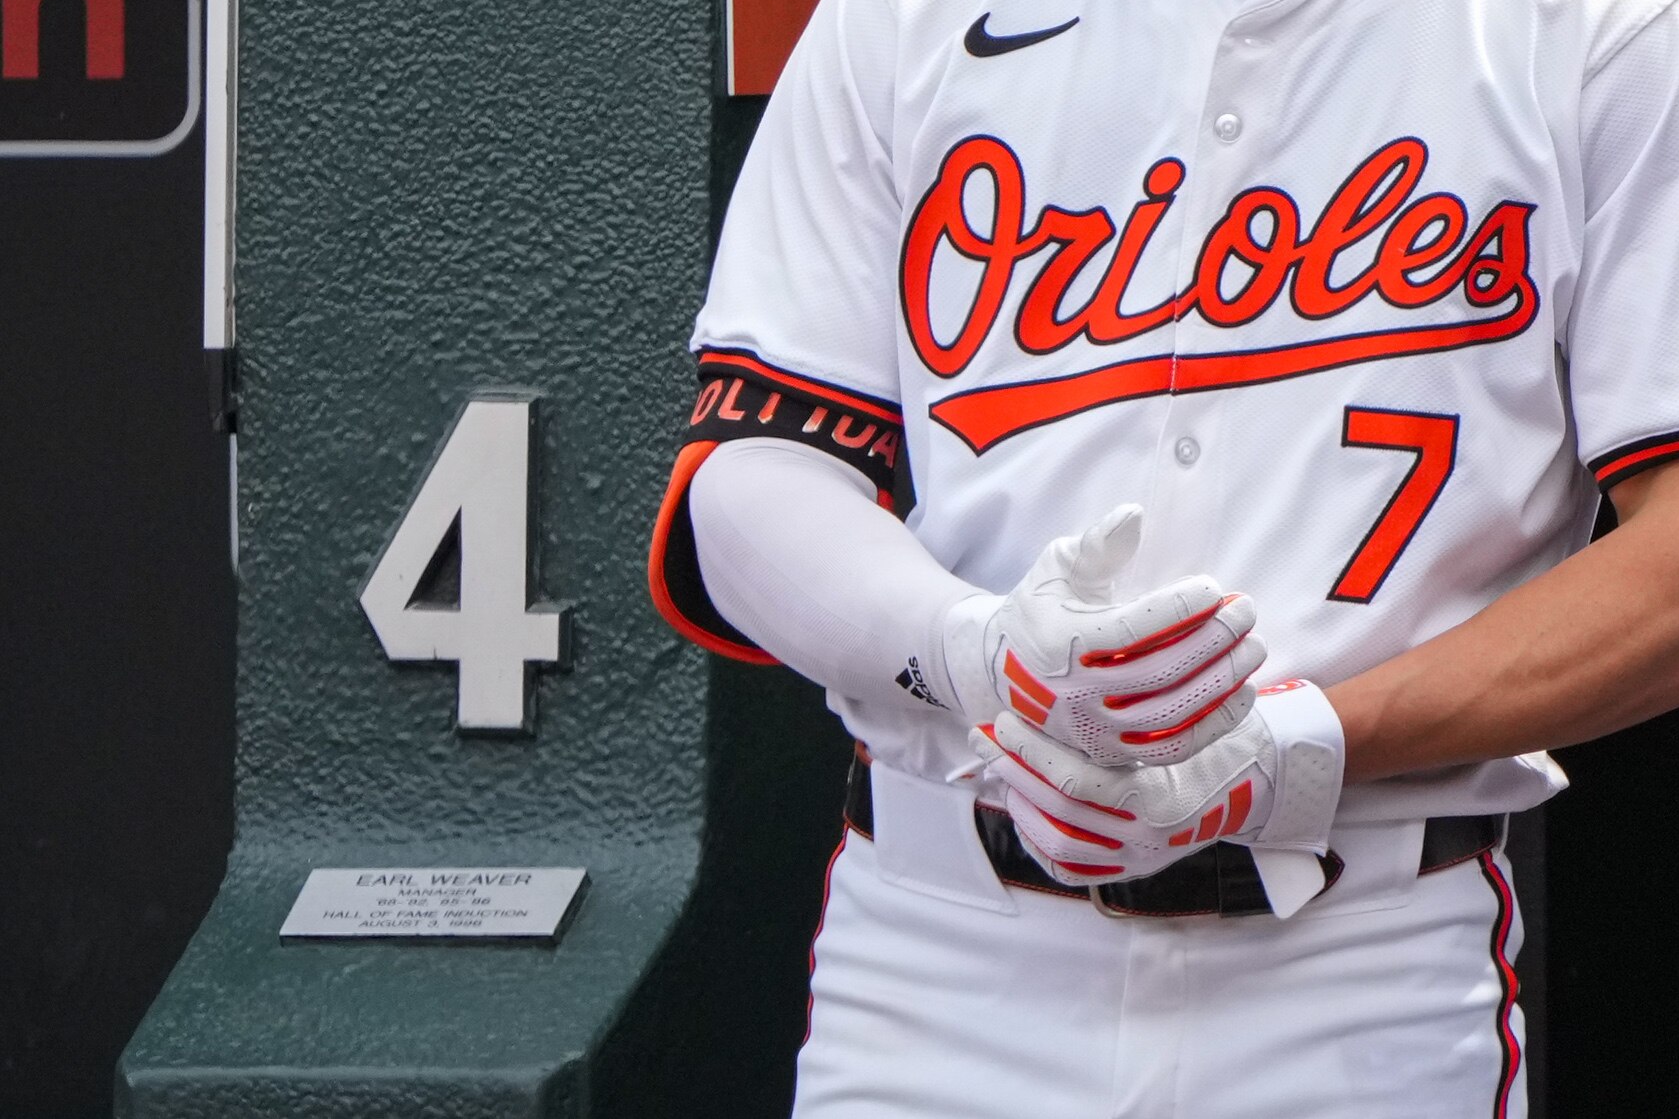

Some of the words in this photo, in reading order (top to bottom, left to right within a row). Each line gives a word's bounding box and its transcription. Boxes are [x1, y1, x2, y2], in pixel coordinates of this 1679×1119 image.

[900, 134, 1540, 379] Orioles
[1326, 404, 1461, 605] 7
[358, 398, 562, 730] 4
[355, 873, 419, 888] EARL
[430, 872, 532, 887] WEAVER
[398, 888, 478, 897] MANAGER
[322, 909, 362, 919] HALL
[369, 910, 393, 919] OF
[396, 910, 439, 919] FAME
[443, 909, 529, 919] INDUCTION
[358, 919, 421, 928] AUGUST
